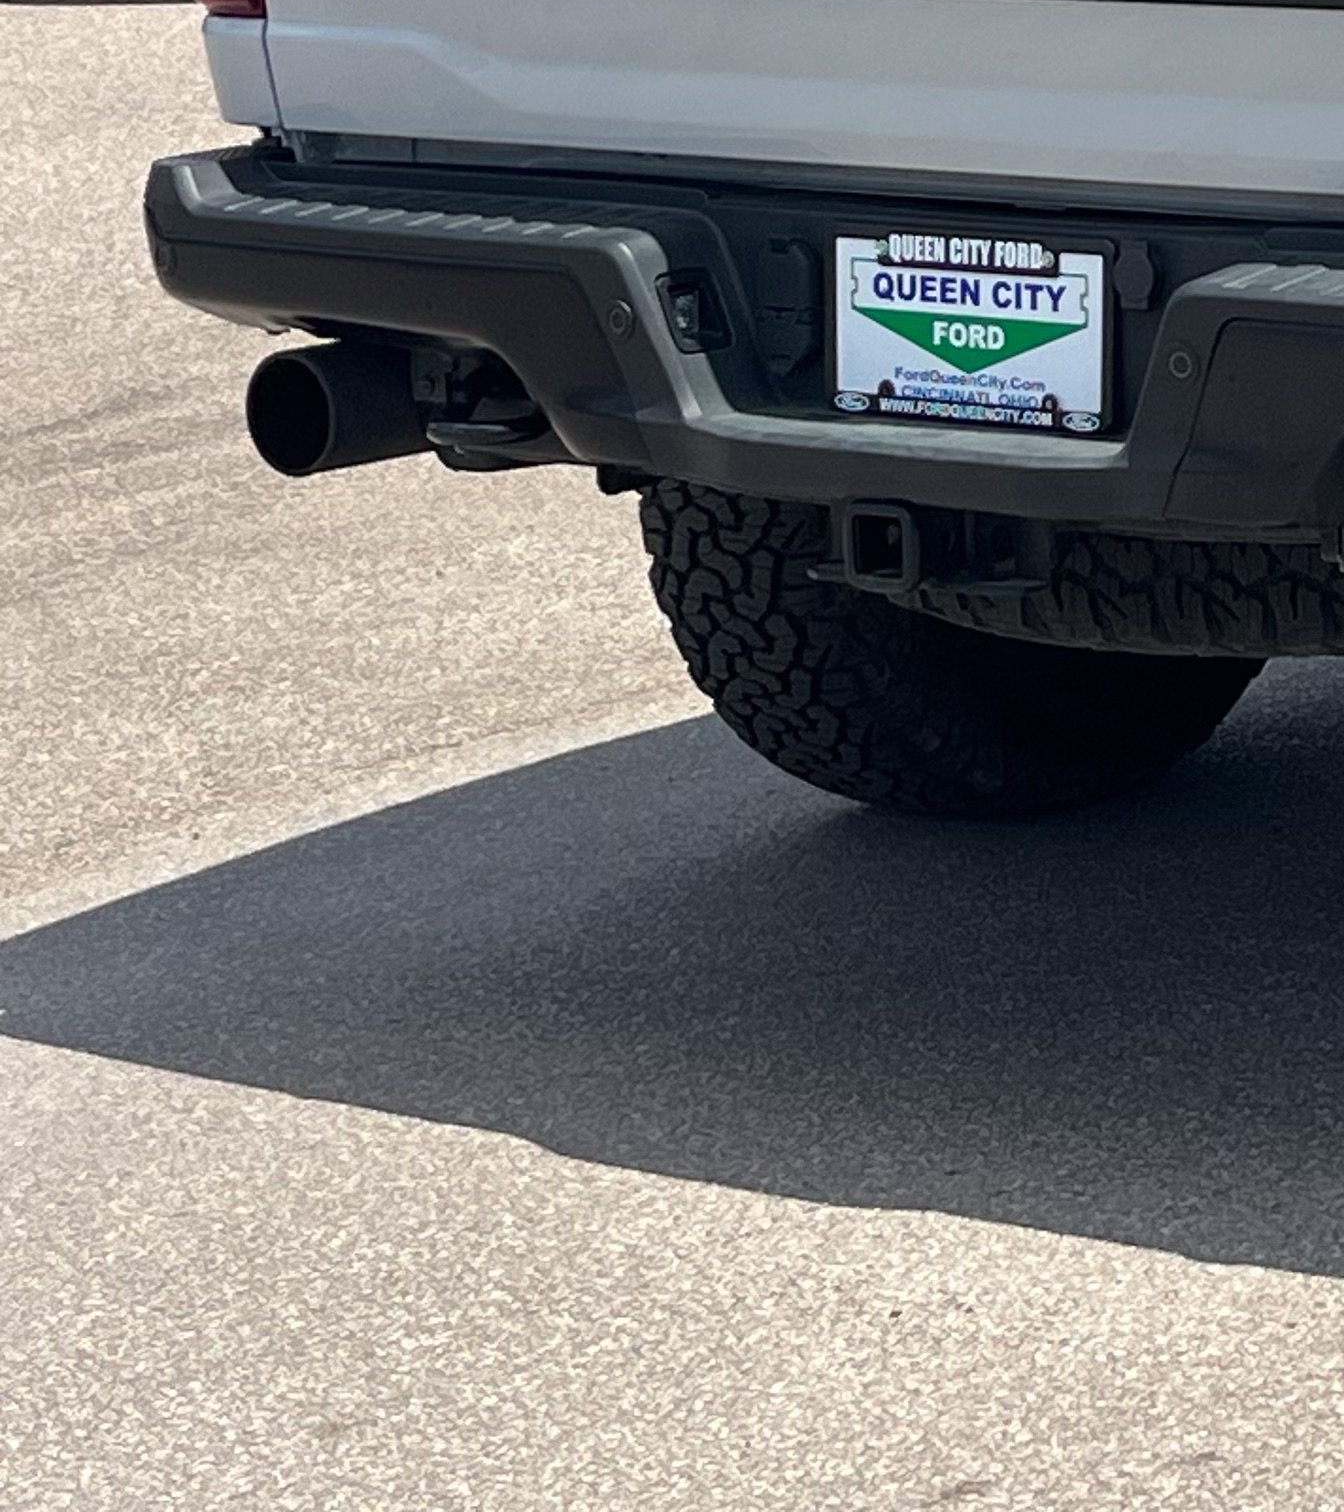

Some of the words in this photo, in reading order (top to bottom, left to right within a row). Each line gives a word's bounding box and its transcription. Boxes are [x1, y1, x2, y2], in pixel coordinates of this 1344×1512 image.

[888, 233, 945, 263] QUEEN
[949, 238, 993, 266] CITY
[994, 241, 1043, 269] FORD
[873, 271, 981, 306] QUEEN
[992, 280, 1067, 312] CITY
[932, 320, 1006, 349] FORD
